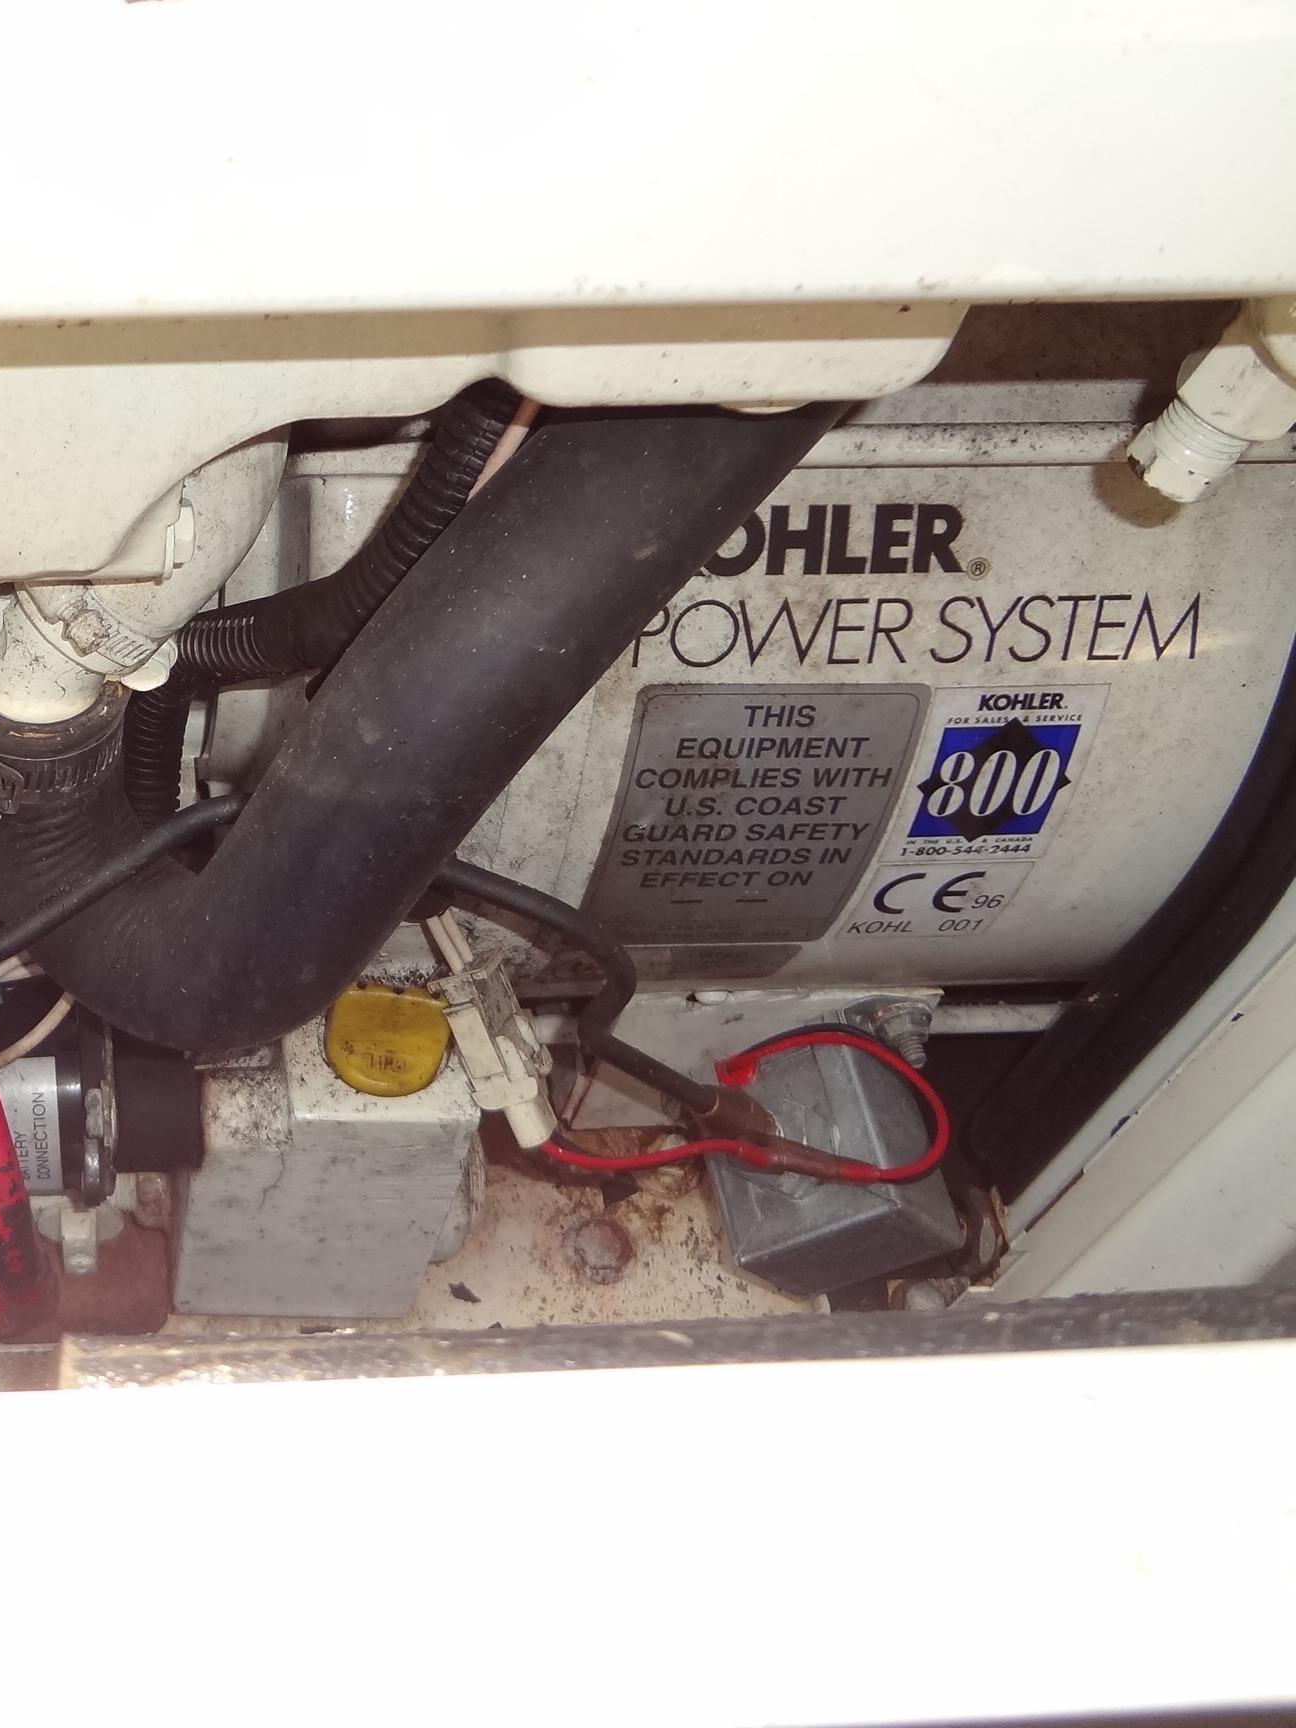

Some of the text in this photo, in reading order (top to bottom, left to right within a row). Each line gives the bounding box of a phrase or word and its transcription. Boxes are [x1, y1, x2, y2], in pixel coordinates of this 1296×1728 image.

[694, 503, 965, 577] OHLER
[631, 591, 1201, 667] POWER SYSTEM
[977, 692, 1065, 711] KOHLER
[744, 704, 817, 728] THIS
[947, 717, 969, 725] FOR
[975, 716, 1009, 724] SALES
[1036, 714, 1083, 722] SERVICE
[676, 736, 870, 760] EQUIPMENT
[635, 767, 893, 789] COMPLIES WITH
[926, 748, 1061, 817] 800
[664, 796, 848, 817] U.S. COAST
[622, 822, 871, 843] GUARD SAFETY
[620, 847, 853, 867] STANDARDS IN
[639, 870, 814, 888] EFFECT ON
[873, 871, 987, 915] CE
[971, 894, 1005, 909] 96
[847, 918, 984, 935] KOHL 001
[32, 1091, 51, 1180] CONNECTION
